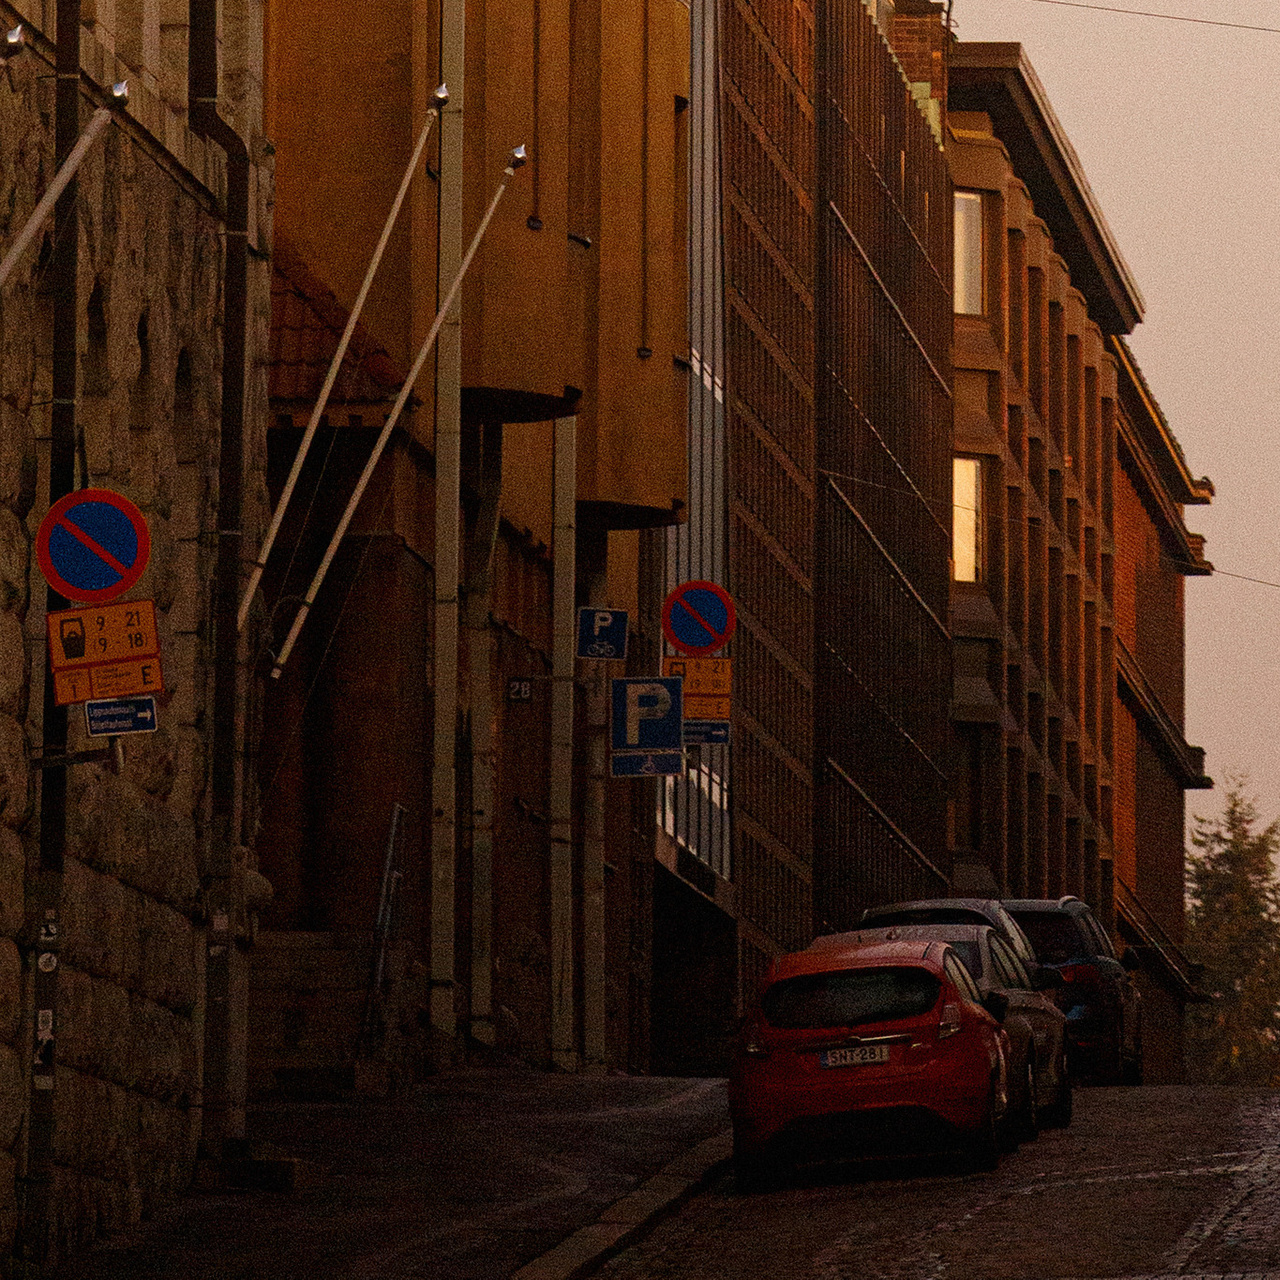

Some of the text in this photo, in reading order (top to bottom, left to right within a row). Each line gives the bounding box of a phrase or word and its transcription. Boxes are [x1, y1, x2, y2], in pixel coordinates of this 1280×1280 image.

[96, 616, 105, 631] 9
[125, 611, 141, 627] 21
[593, 611, 614, 636] P
[141, 665, 154, 685] E
[626, 683, 672, 745] P
[830, 1047, 883, 1064] SNT-281
